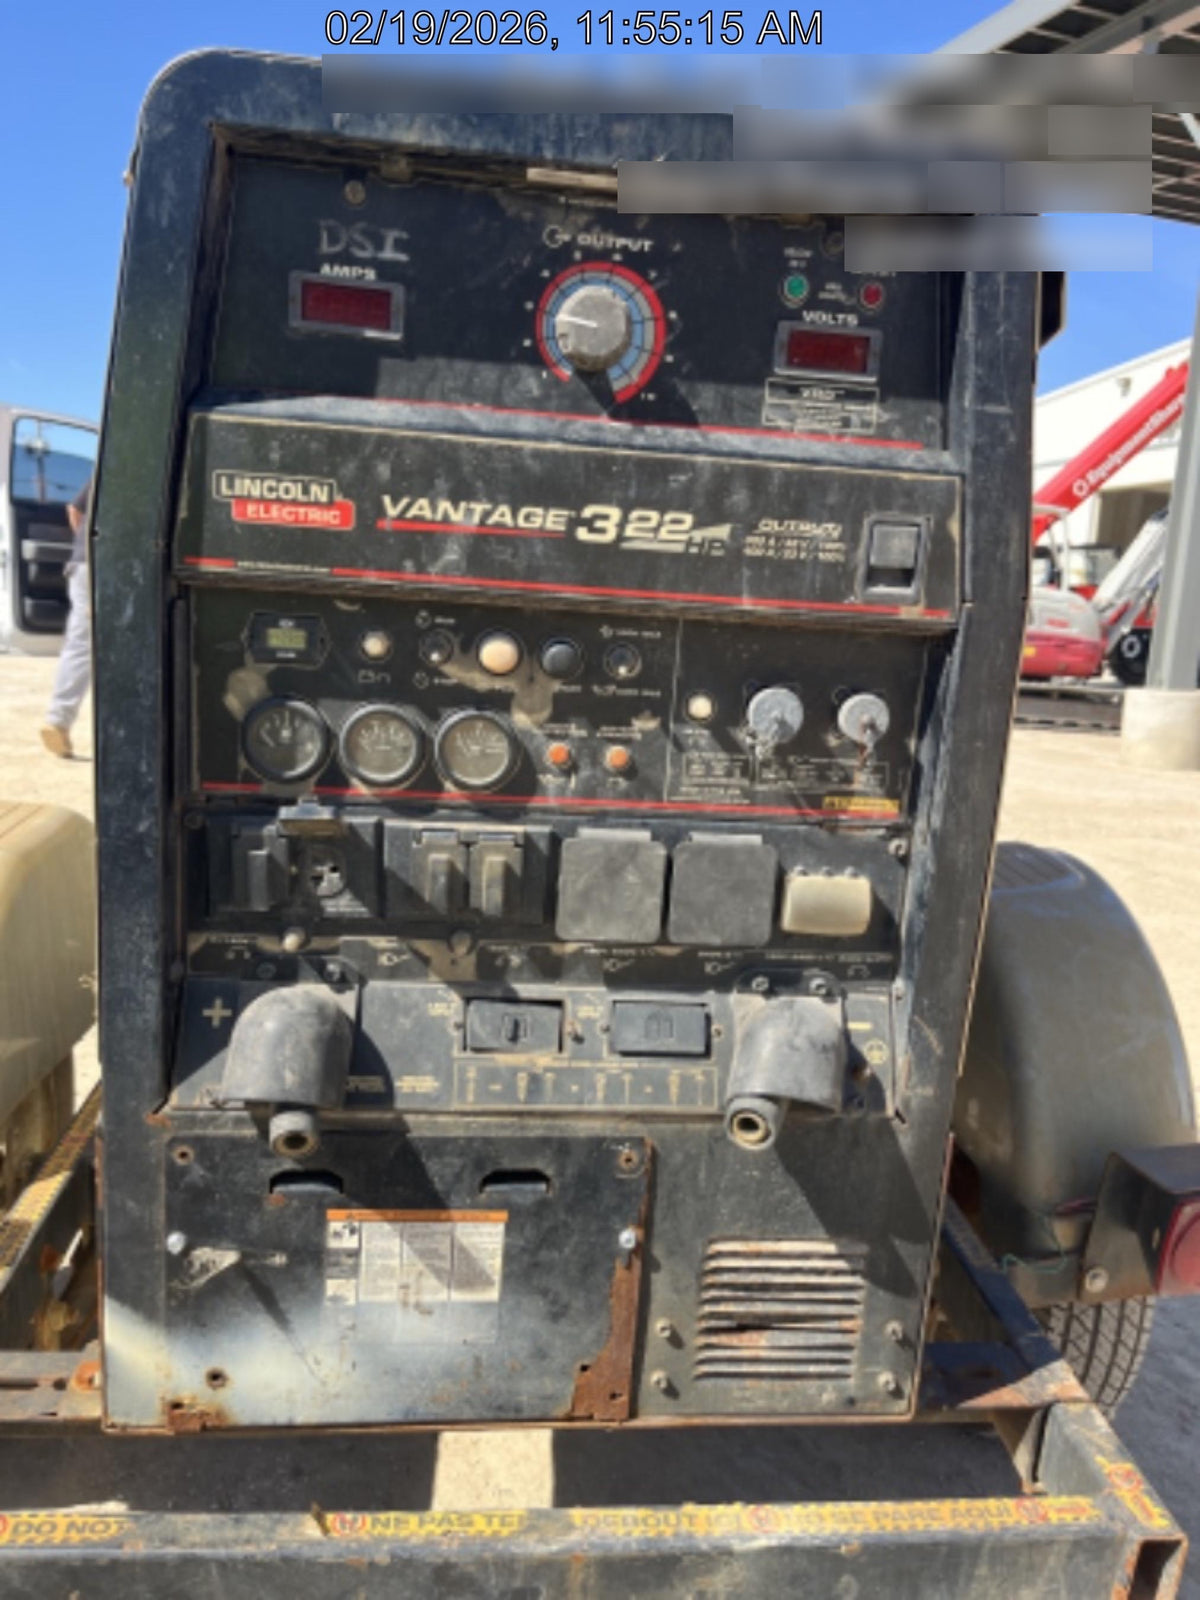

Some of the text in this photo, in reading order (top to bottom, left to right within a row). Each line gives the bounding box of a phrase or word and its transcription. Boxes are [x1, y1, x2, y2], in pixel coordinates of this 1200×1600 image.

[577, 231, 653, 252] OUTPUT
[801, 310, 859, 327] VOLTS
[219, 474, 330, 504] LINCOLN
[245, 502, 342, 526] ELECTRIC
[381, 494, 694, 545] VANTAGE 322
[11, 1520, 57, 1536] DO
[483, 1512, 523, 1528] TE
